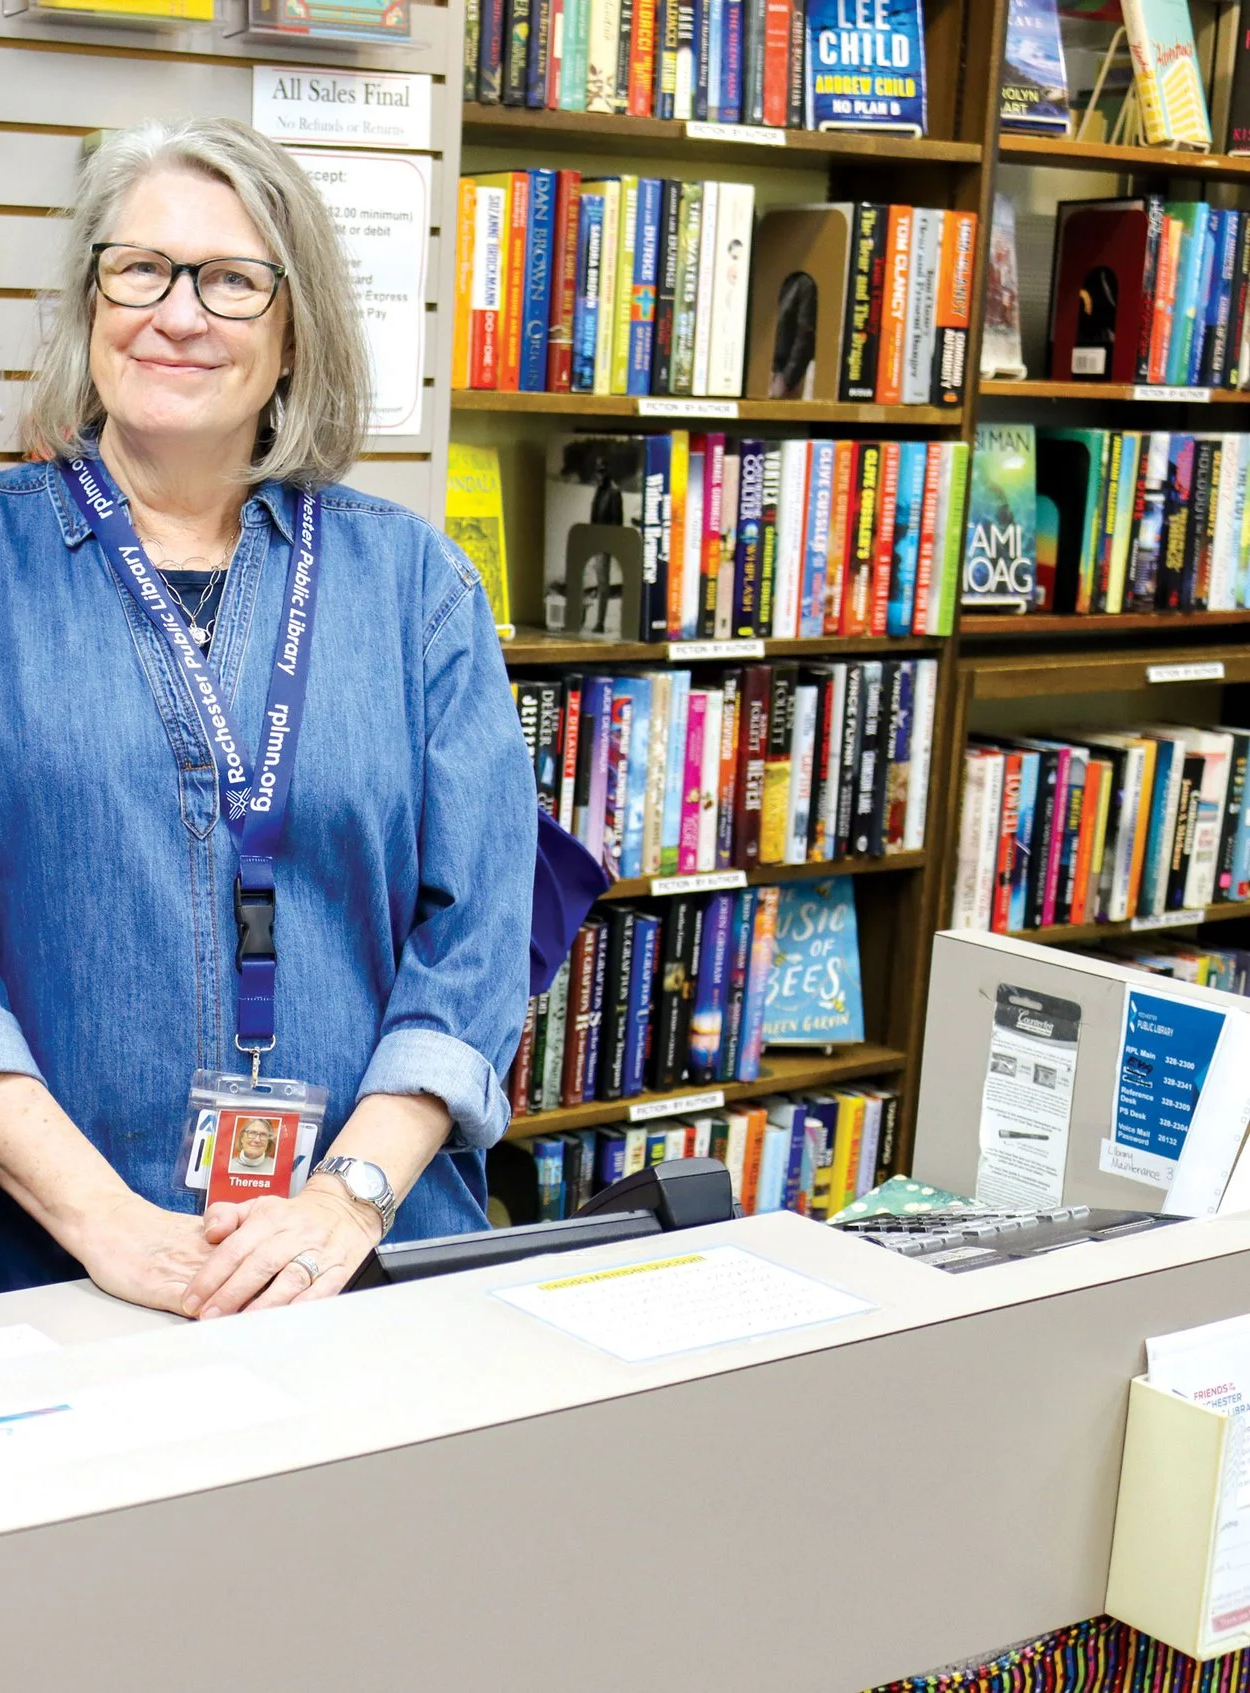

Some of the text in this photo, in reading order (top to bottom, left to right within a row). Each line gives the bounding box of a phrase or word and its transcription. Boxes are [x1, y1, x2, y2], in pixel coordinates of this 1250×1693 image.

[538, 3, 549, 75] PURPLE LINE
[837, 0, 892, 30] LEE
[727, 8, 739, 99] THE SILENT MAN
[819, 31, 910, 68] CHILD
[272, 77, 410, 107] All Sales Final
[815, 75, 916, 98] ANDREW CHILD
[832, 99, 900, 115] NO PLAN B
[277, 116, 405, 136] No Refunds or Returns
[536, 176, 550, 220] DAN
[530, 228, 548, 301] BROWN
[589, 224, 601, 267] SANDRA
[365, 290, 408, 302] Express
[367, 308, 387, 320] Pay
[586, 269, 598, 309] BROWN
[848, 210, 877, 381] The Bear and The Dragon
[941, 328, 955, 390] AUTHORITY
[952, 331, 966, 387] COMMAND
[740, 454, 757, 520] COULTER
[884, 442, 900, 493] DEBORAH
[1105, 435, 1122, 536] JONATHAN KELLERMAN
[812, 446, 833, 552] CLIVE CUSSLER
[880, 496, 895, 542] CROMBIE
[1234, 467, 1247, 521] THE PLOT
[643, 473, 664, 584] Without Remorse
[759, 451, 781, 623] VORTEX CATHERINE COULTER
[296, 548, 315, 605] Public
[742, 544, 757, 612] WHIPLASH
[875, 564, 890, 598] BITTER
[118, 545, 246, 783] Rochester Public Library
[277, 602, 306, 677] Library
[539, 689, 555, 746] DEKKER
[564, 696, 580, 777] JP DELANEY
[599, 686, 612, 774] JUDE DEVERAUX
[721, 678, 737, 761] THE SURVIVOR
[748, 700, 763, 752] FOLLETT
[771, 679, 789, 745] FOLLETT
[843, 668, 861, 766] VINCE FLYNN
[887, 670, 901, 759] VINCE FLYNN
[251, 702, 291, 812] rplmn.org
[613, 704, 633, 842] UNTAMED GLENNON DOYLE
[745, 759, 766, 811] NEVER
[1002, 773, 1021, 837] LOWELL
[1180, 778, 1192, 810] James
[1172, 824, 1185, 871] Michener
[1183, 789, 1200, 855] Centennial
[659, 880, 689, 890] FICTION
[708, 875, 739, 886] AUTHOR
[713, 897, 729, 984] JOHN GRISHAM
[809, 936, 835, 958] OF
[1137, 1019, 1174, 1037] PUBLIC LIBRARY
[1126, 1045, 1195, 1071] RPL Main 328-2300
[637, 1094, 716, 1116] FICTION BY AUTHOR
[1120, 1095, 1137, 1106] Desk
[1121, 1086, 1191, 1112] Reference 328-2309
[1163, 1076, 1192, 1092] 328-2341
[1118, 1122, 1178, 1147] Voice Mail 26132
[1118, 1130, 1149, 1146] Password
[1119, 1106, 1188, 1133] PS Desk 328-2304
[229, 1176, 271, 1188] Theresa
[1111, 1157, 1161, 1181] Maintenance
[1194, 1383, 1228, 1400] FRIENDS
